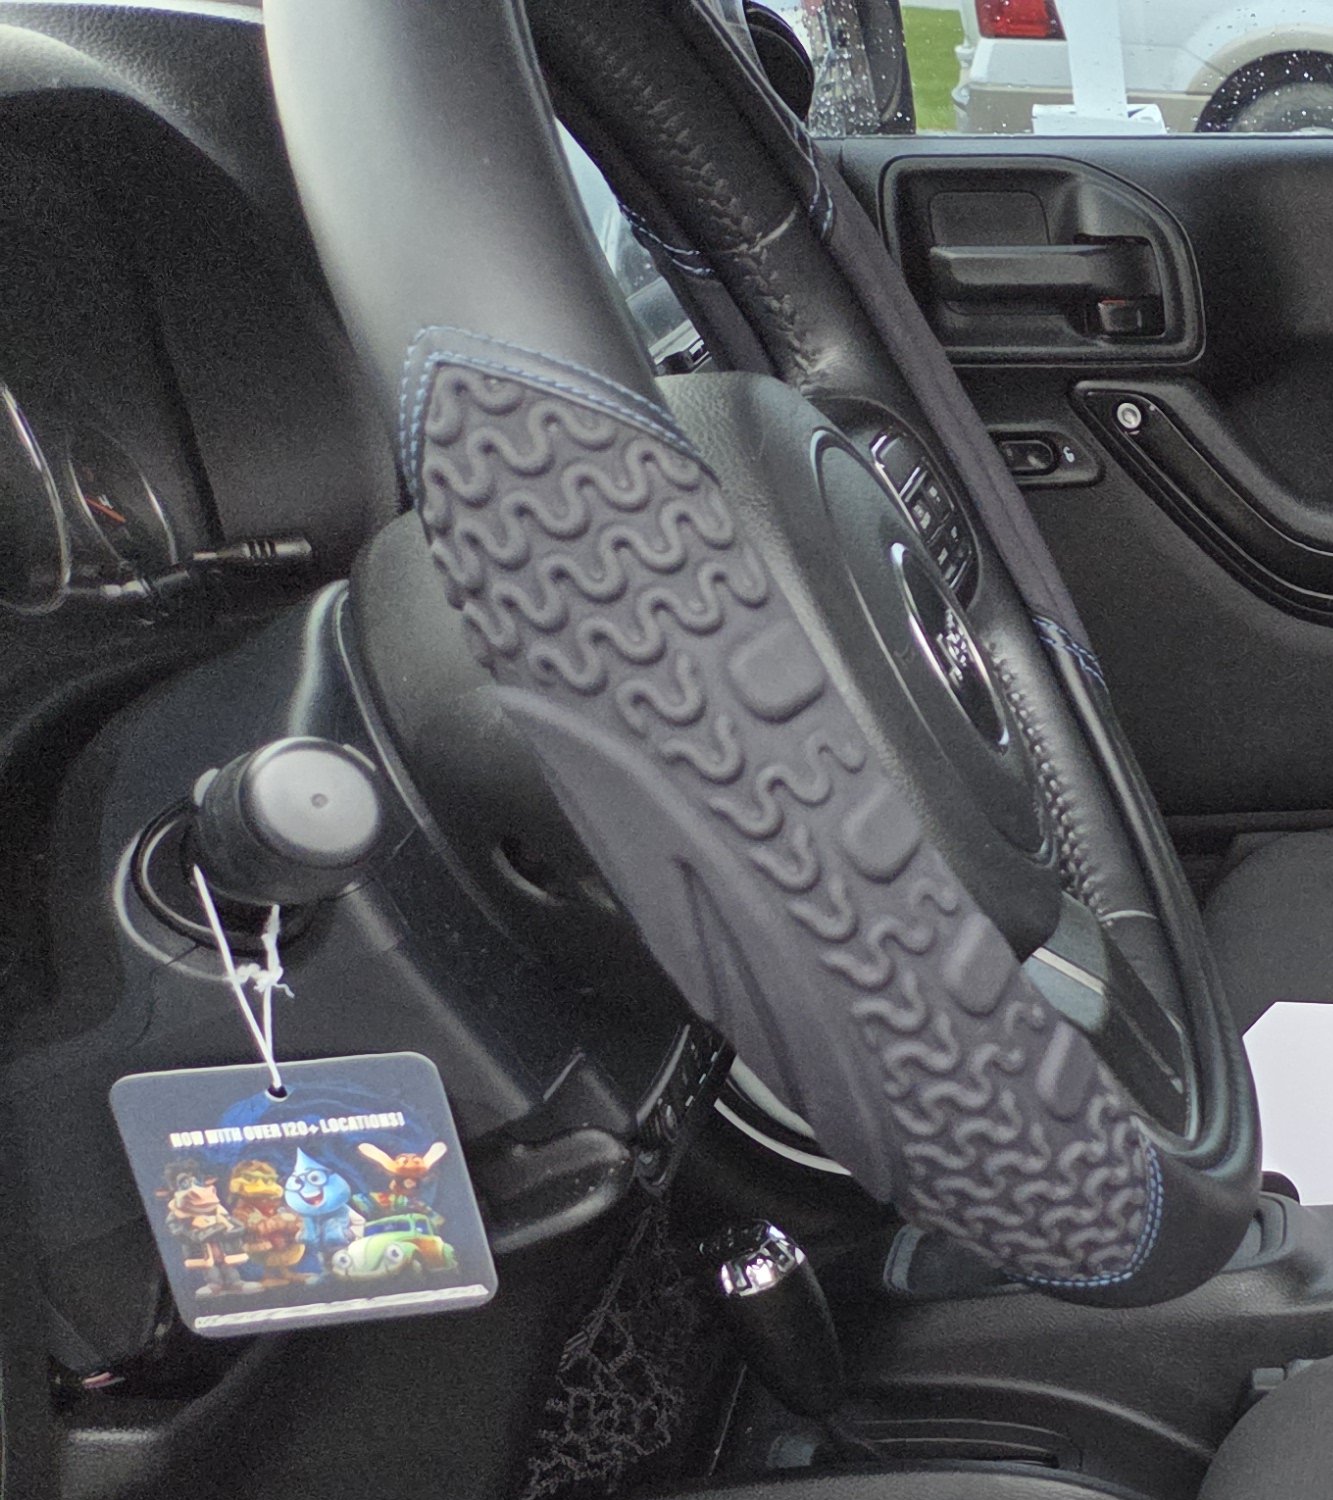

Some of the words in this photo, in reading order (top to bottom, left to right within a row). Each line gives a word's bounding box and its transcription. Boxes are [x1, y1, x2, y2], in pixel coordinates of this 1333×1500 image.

[170, 1131, 204, 1147] NOW
[205, 1127, 243, 1144] WITH
[243, 1123, 282, 1140] OVER
